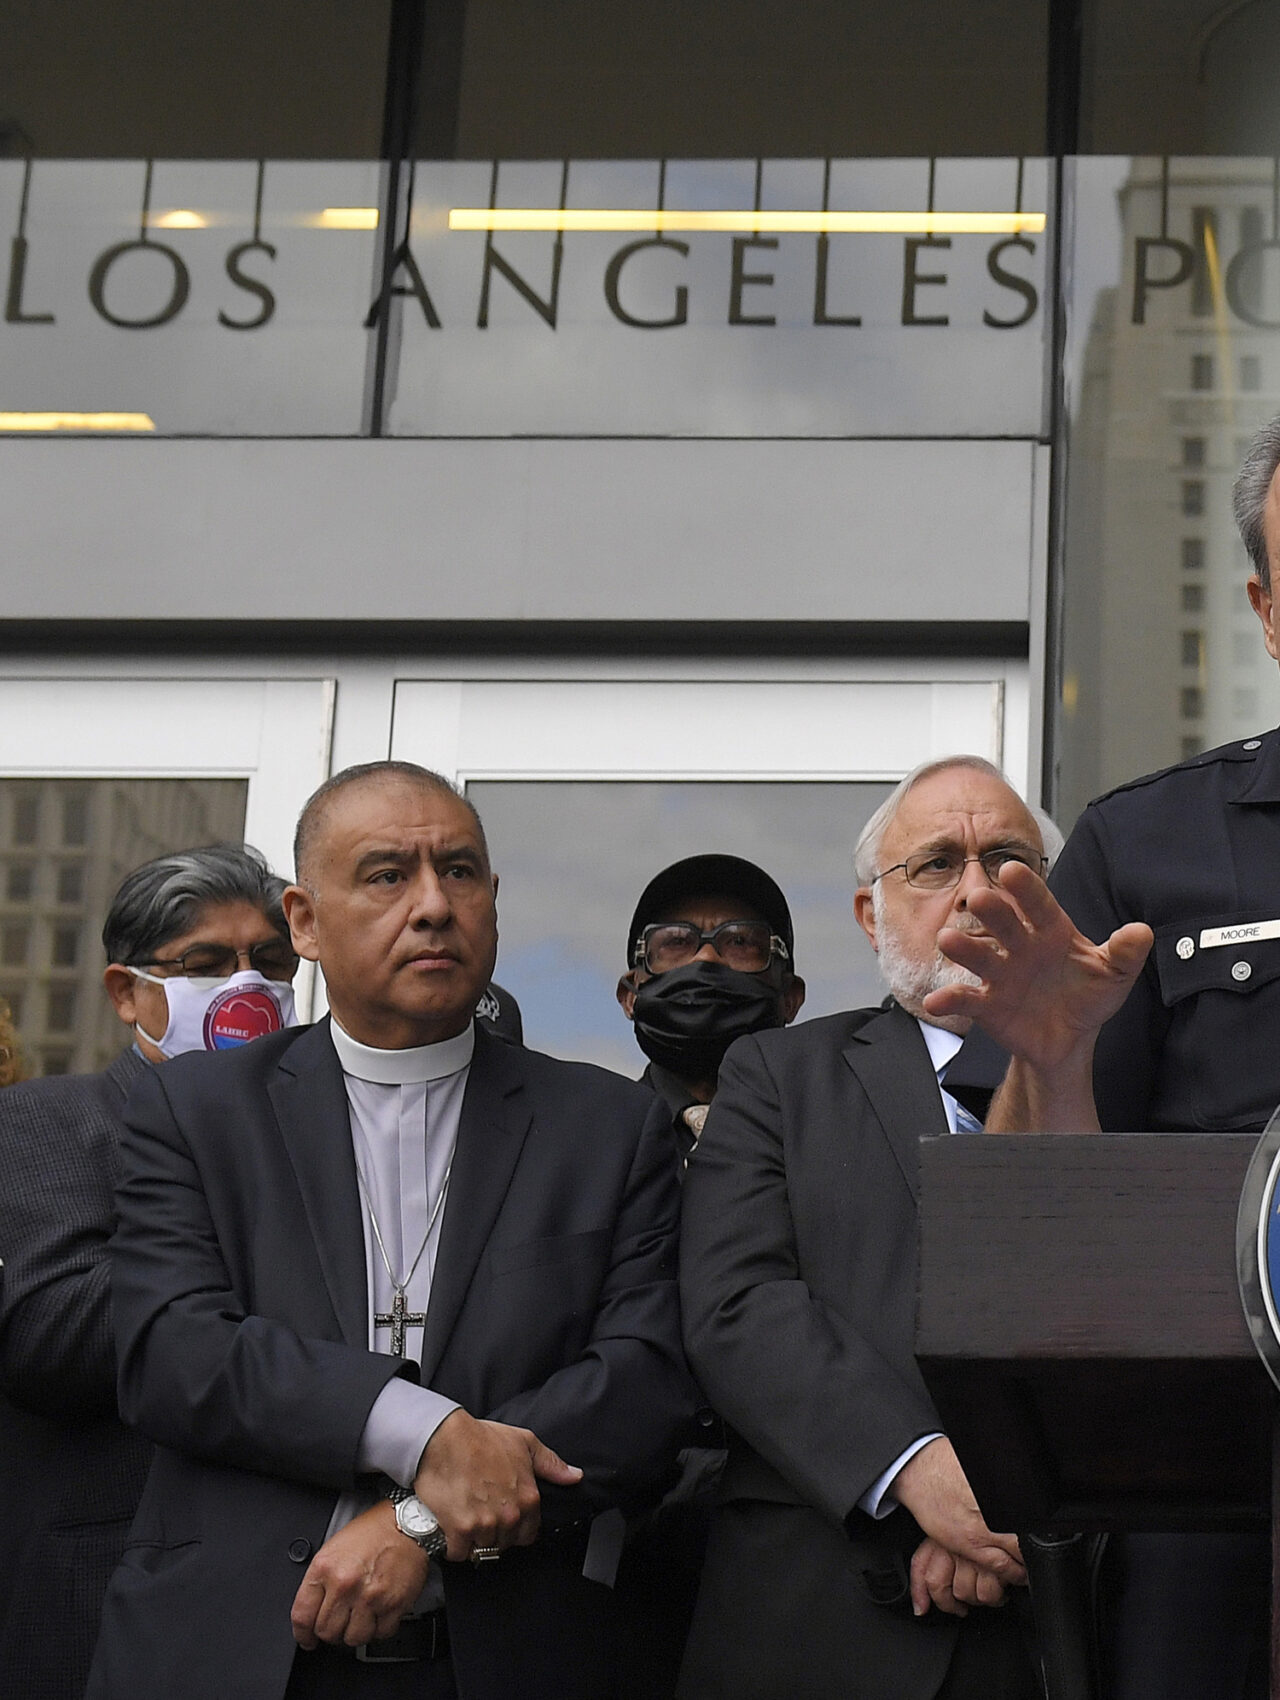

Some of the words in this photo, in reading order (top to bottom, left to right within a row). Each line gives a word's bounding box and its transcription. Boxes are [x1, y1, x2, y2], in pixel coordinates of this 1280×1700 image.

[4, 237, 276, 330] LOS
[364, 237, 1039, 331] ANGELES
[1220, 926, 1261, 940] MOORE
